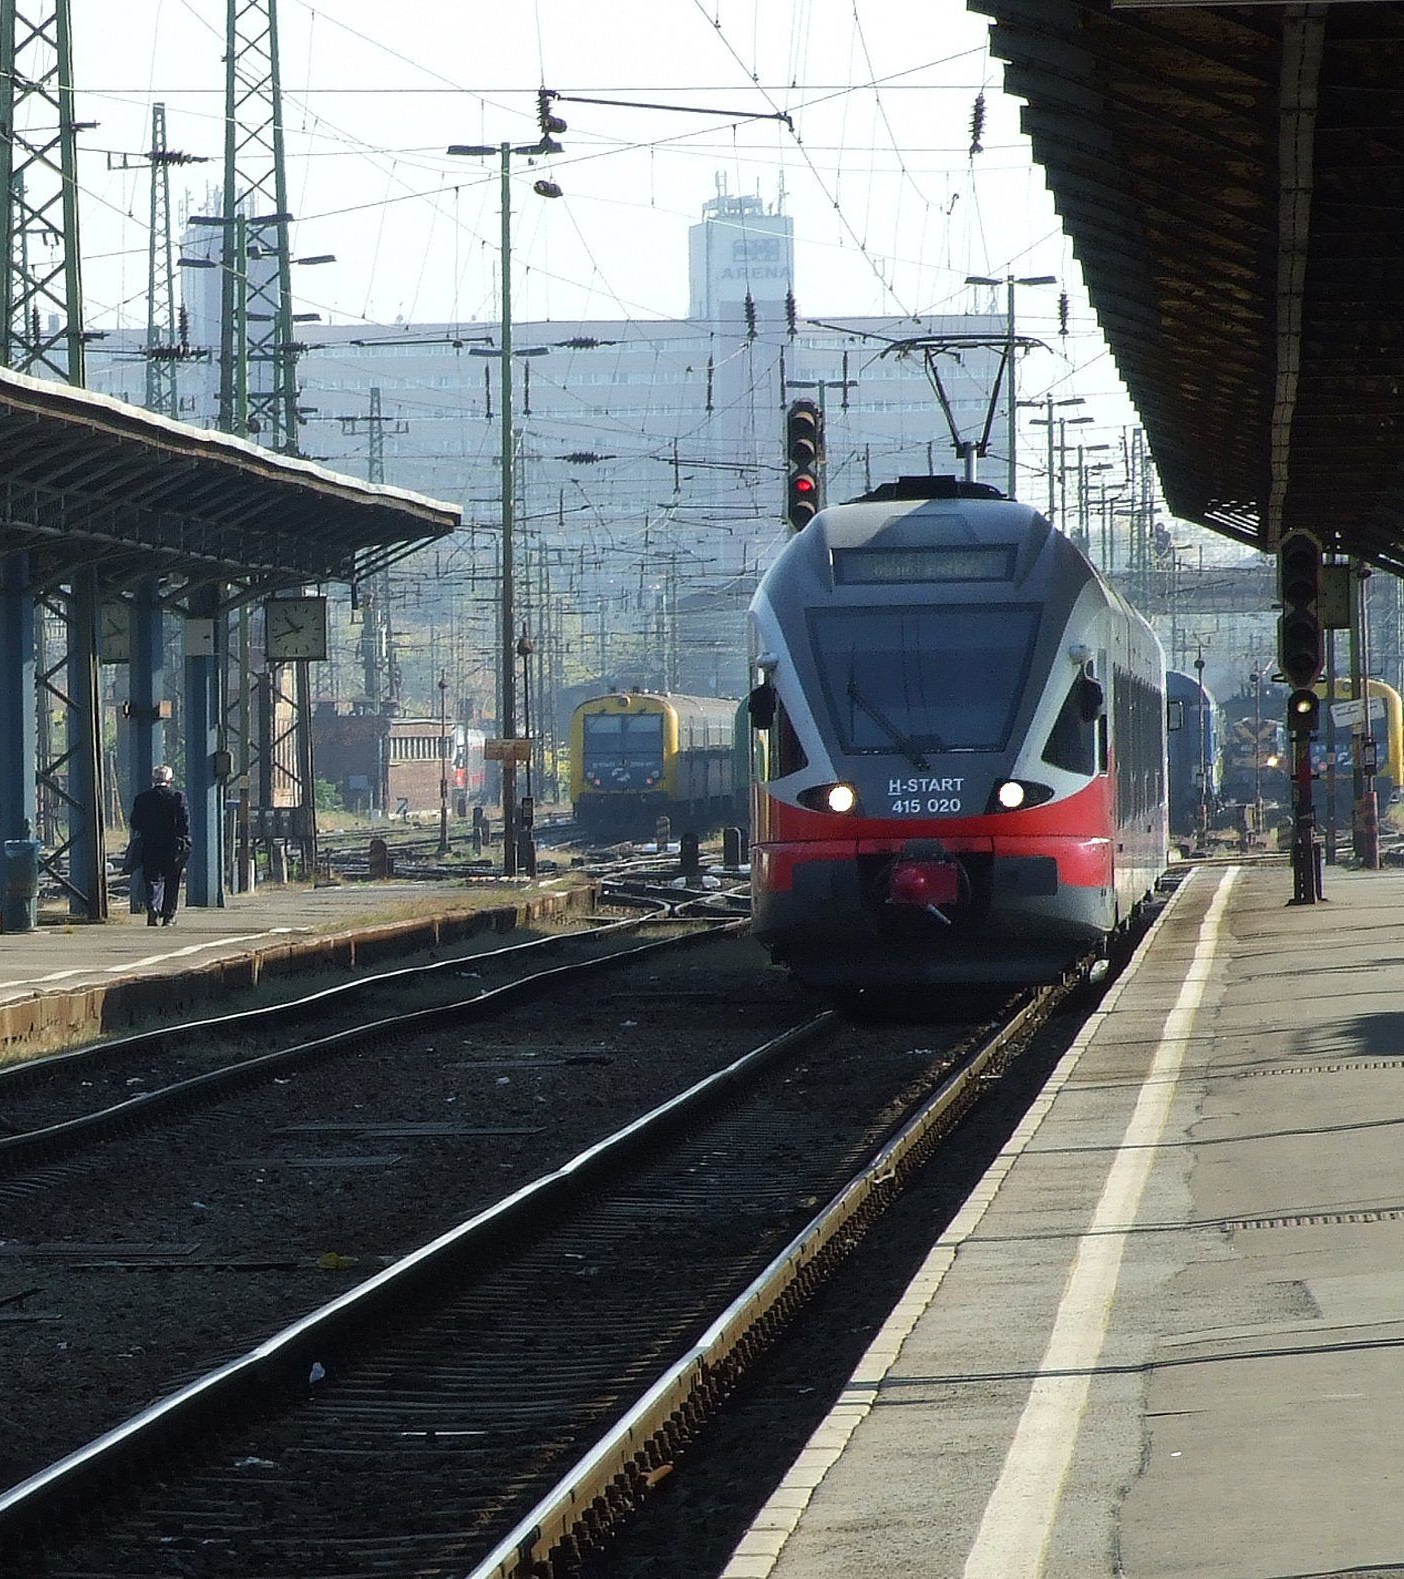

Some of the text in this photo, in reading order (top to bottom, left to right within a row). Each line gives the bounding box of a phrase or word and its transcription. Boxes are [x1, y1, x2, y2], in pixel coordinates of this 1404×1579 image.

[721, 267, 791, 279] ARENA
[888, 778, 964, 795] H-START
[892, 798, 961, 813] 415 020
